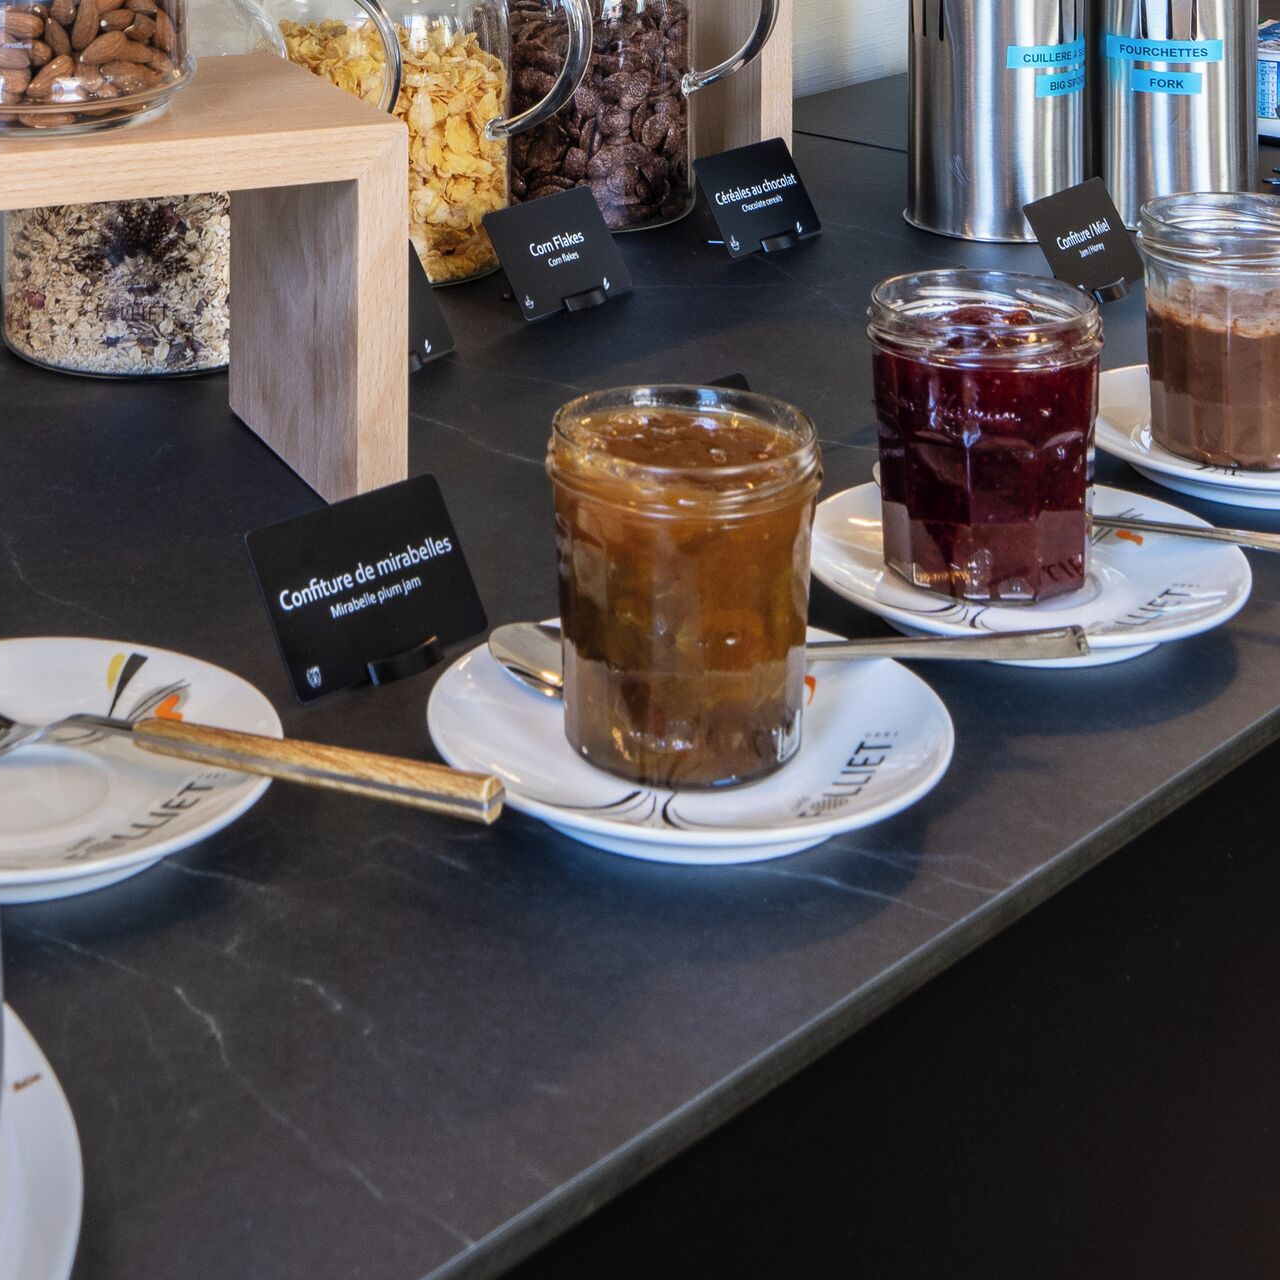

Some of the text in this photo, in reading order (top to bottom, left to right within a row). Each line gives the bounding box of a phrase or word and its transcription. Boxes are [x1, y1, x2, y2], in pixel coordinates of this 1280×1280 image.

[1119, 43, 1209, 58] FOURCHETTES
[1049, 79, 1067, 91] BIG
[1149, 77, 1185, 90] FORK
[715, 173, 797, 205] Céréales au chocolat
[529, 230, 585, 257] Corn Flakes
[1056, 228, 1092, 250] Confiture
[1092, 217, 1111, 236] Miel
[548, 250, 580, 268] Corn flakes
[279, 536, 453, 612] Confiture de mirabelles
[330, 575, 422, 620] Mirabelle plum jam
